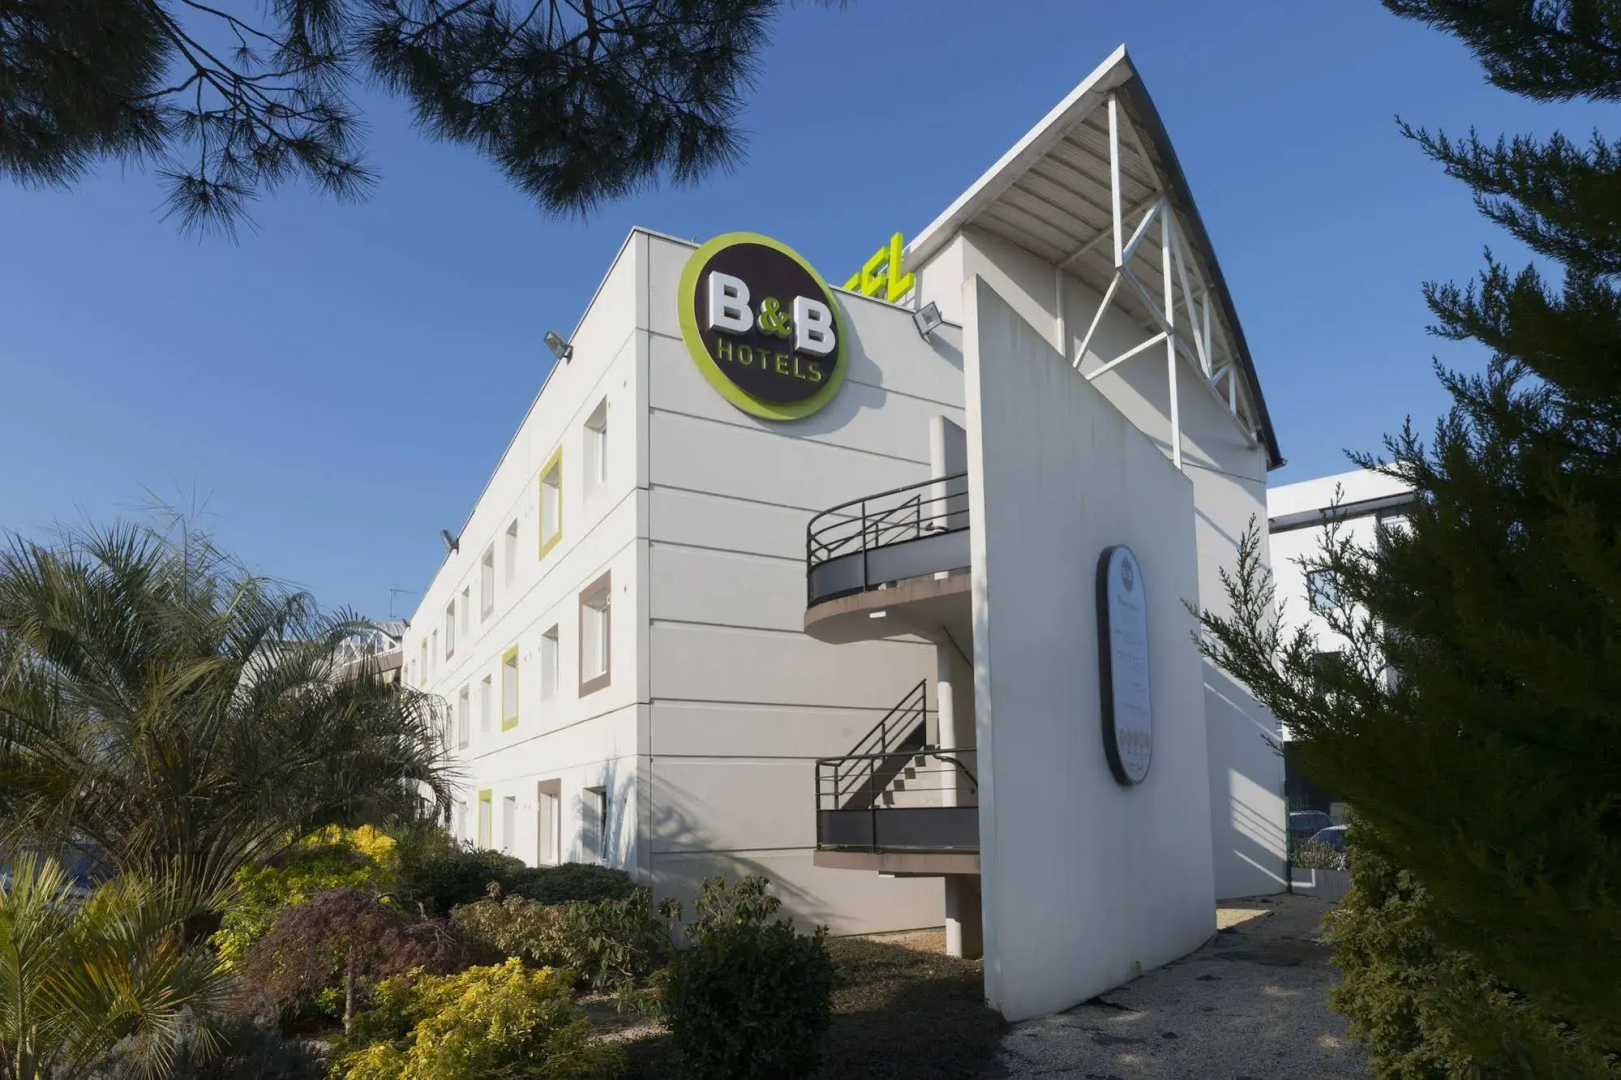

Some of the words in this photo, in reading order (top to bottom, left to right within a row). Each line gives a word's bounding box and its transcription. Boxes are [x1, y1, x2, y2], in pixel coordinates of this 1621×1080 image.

[842, 231, 915, 303] EL
[708, 270, 836, 357] B&B
[717, 337, 822, 382] HOTELS
